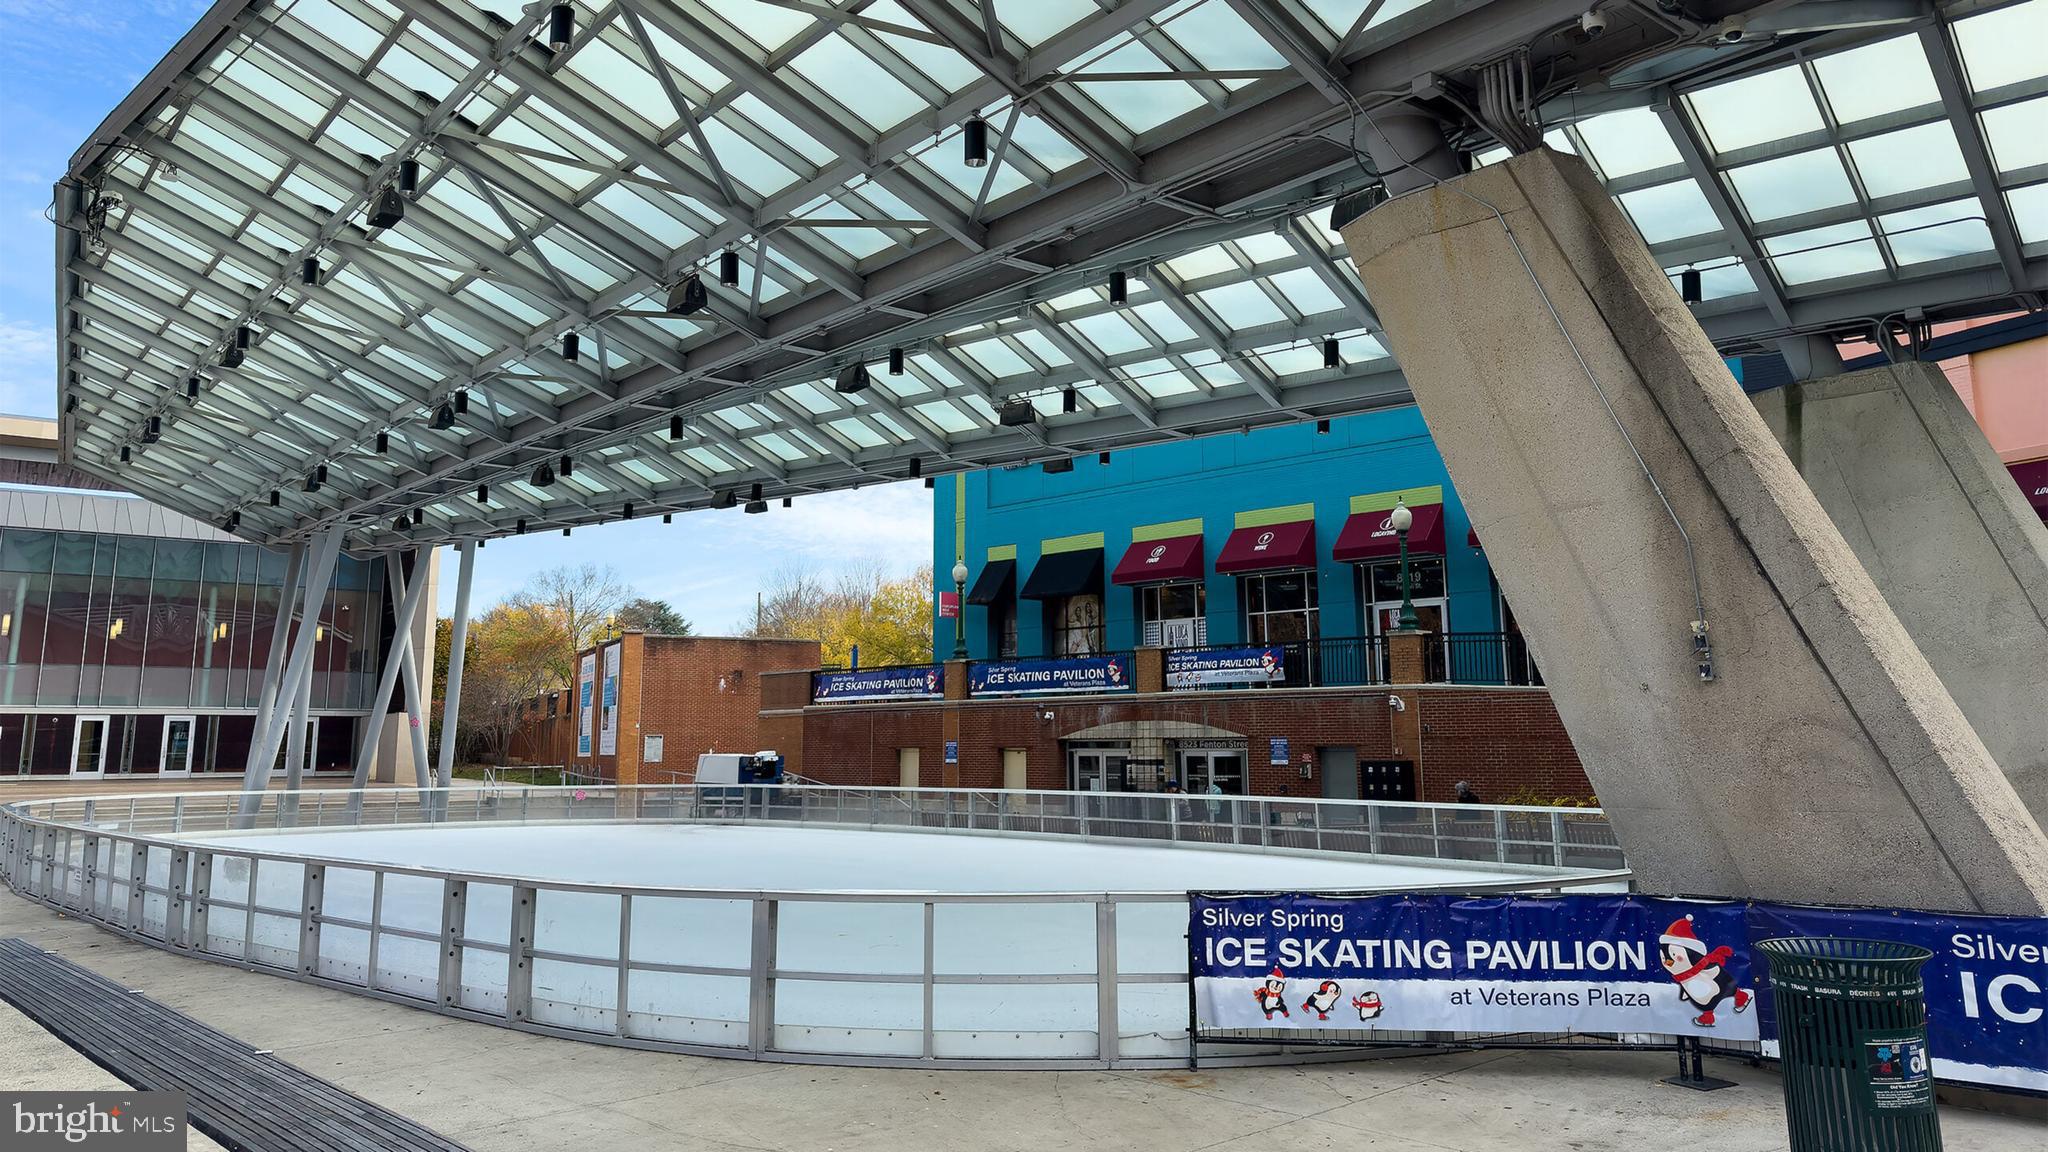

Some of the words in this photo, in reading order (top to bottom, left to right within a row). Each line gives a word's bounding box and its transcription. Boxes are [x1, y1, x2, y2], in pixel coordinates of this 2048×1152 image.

[1396, 571, 1421, 583] 819
[1168, 662, 1180, 672] ICE
[1181, 661, 1218, 670] SKATING
[1220, 658, 1260, 668] PAVILION
[987, 673, 1005, 684] ICE
[1008, 671, 1050, 683] SKATING
[1053, 668, 1105, 681] PAVILION
[830, 682, 844, 692] ICE
[846, 680, 881, 690] SKATING
[883, 678, 923, 688] PAVILION
[1179, 739, 1198, 748] 8523
[1200, 739, 1227, 748] Fenton
[1202, 908, 1264, 927] Silver
[1271, 909, 1344, 932] Spring
[1205, 937, 1267, 967] ICE
[1278, 938, 1452, 969] SKATING
[1466, 940, 1647, 971] PAVILION
[1790, 983, 1808, 991] TRASH
[1814, 986, 1842, 995] BASURA
[1451, 989, 1472, 1005] at
[1478, 987, 1580, 1007] Veterans
[1588, 988, 1651, 1007] Plaza
[1960, 970, 2044, 1024] IC
